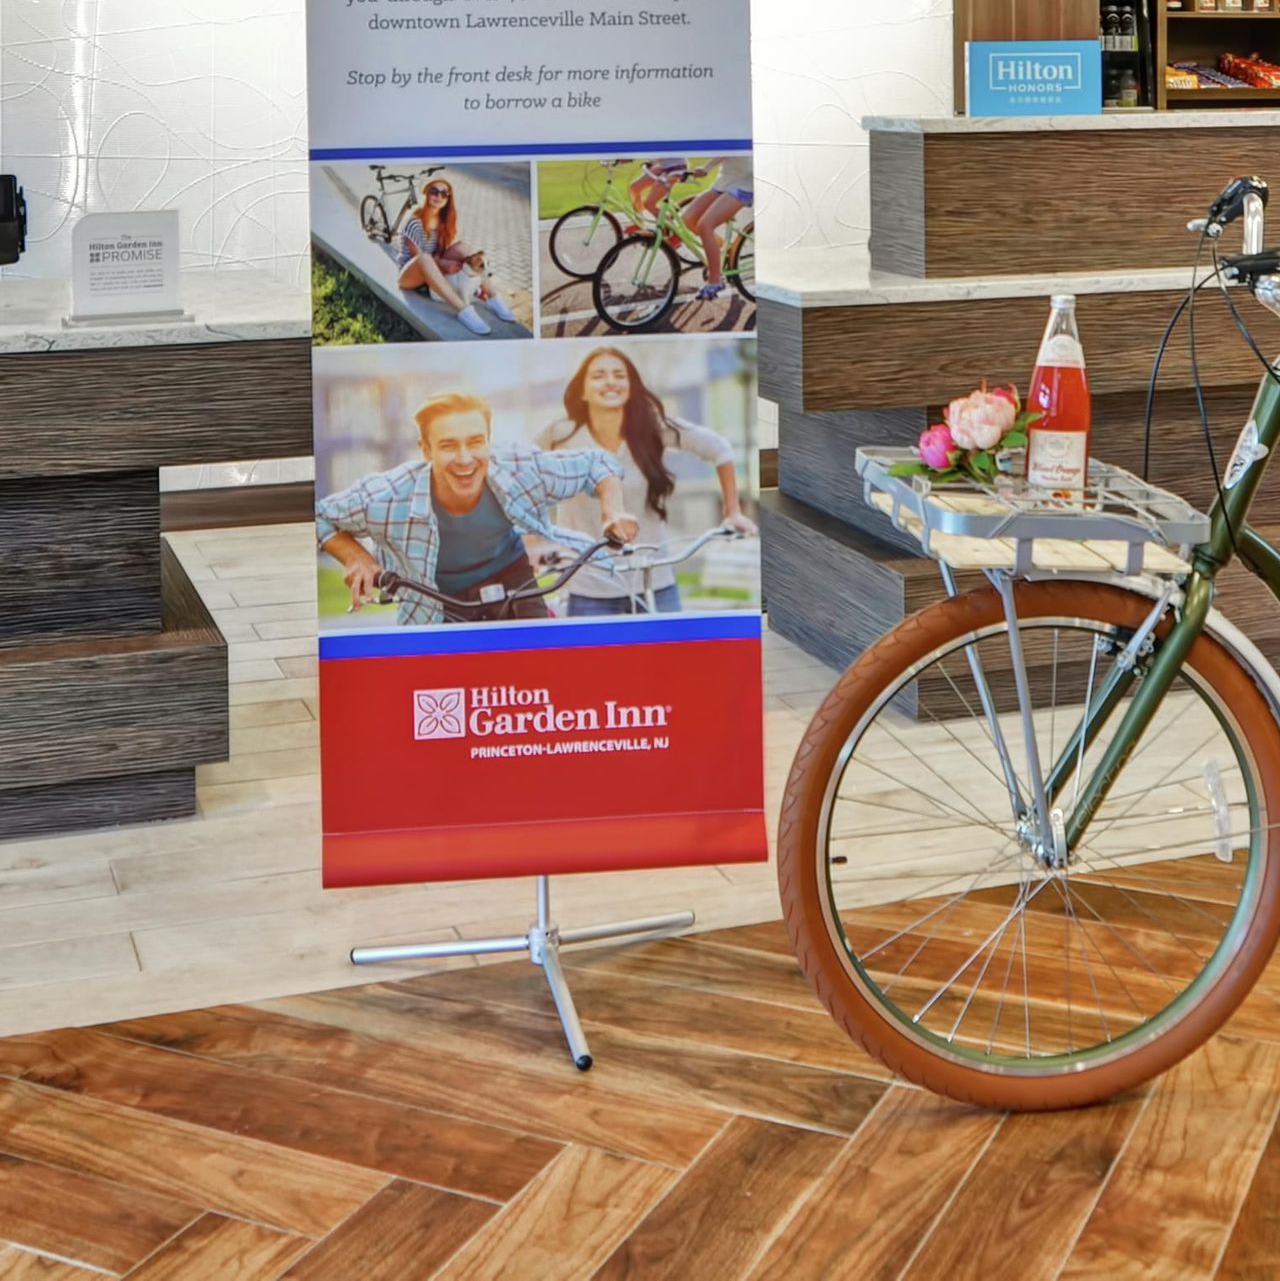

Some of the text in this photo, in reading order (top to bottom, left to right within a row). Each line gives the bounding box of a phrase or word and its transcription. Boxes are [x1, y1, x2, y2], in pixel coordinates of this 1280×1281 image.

[368, 10, 690, 30] downtown Lawrenceville Main Street.
[347, 63, 715, 88] Stop by the front desk for more information
[998, 60, 1073, 80] Hilton
[1009, 84, 1062, 92] HONORS
[463, 91, 602, 110] to borrow a bike
[117, 241, 147, 249] Garden
[102, 249, 162, 262] PROMISE
[471, 686, 550, 708] Hilton
[470, 704, 599, 735] Garden
[471, 737, 669, 759] PRINCETON-LAWRENCEVILLE, NJ
